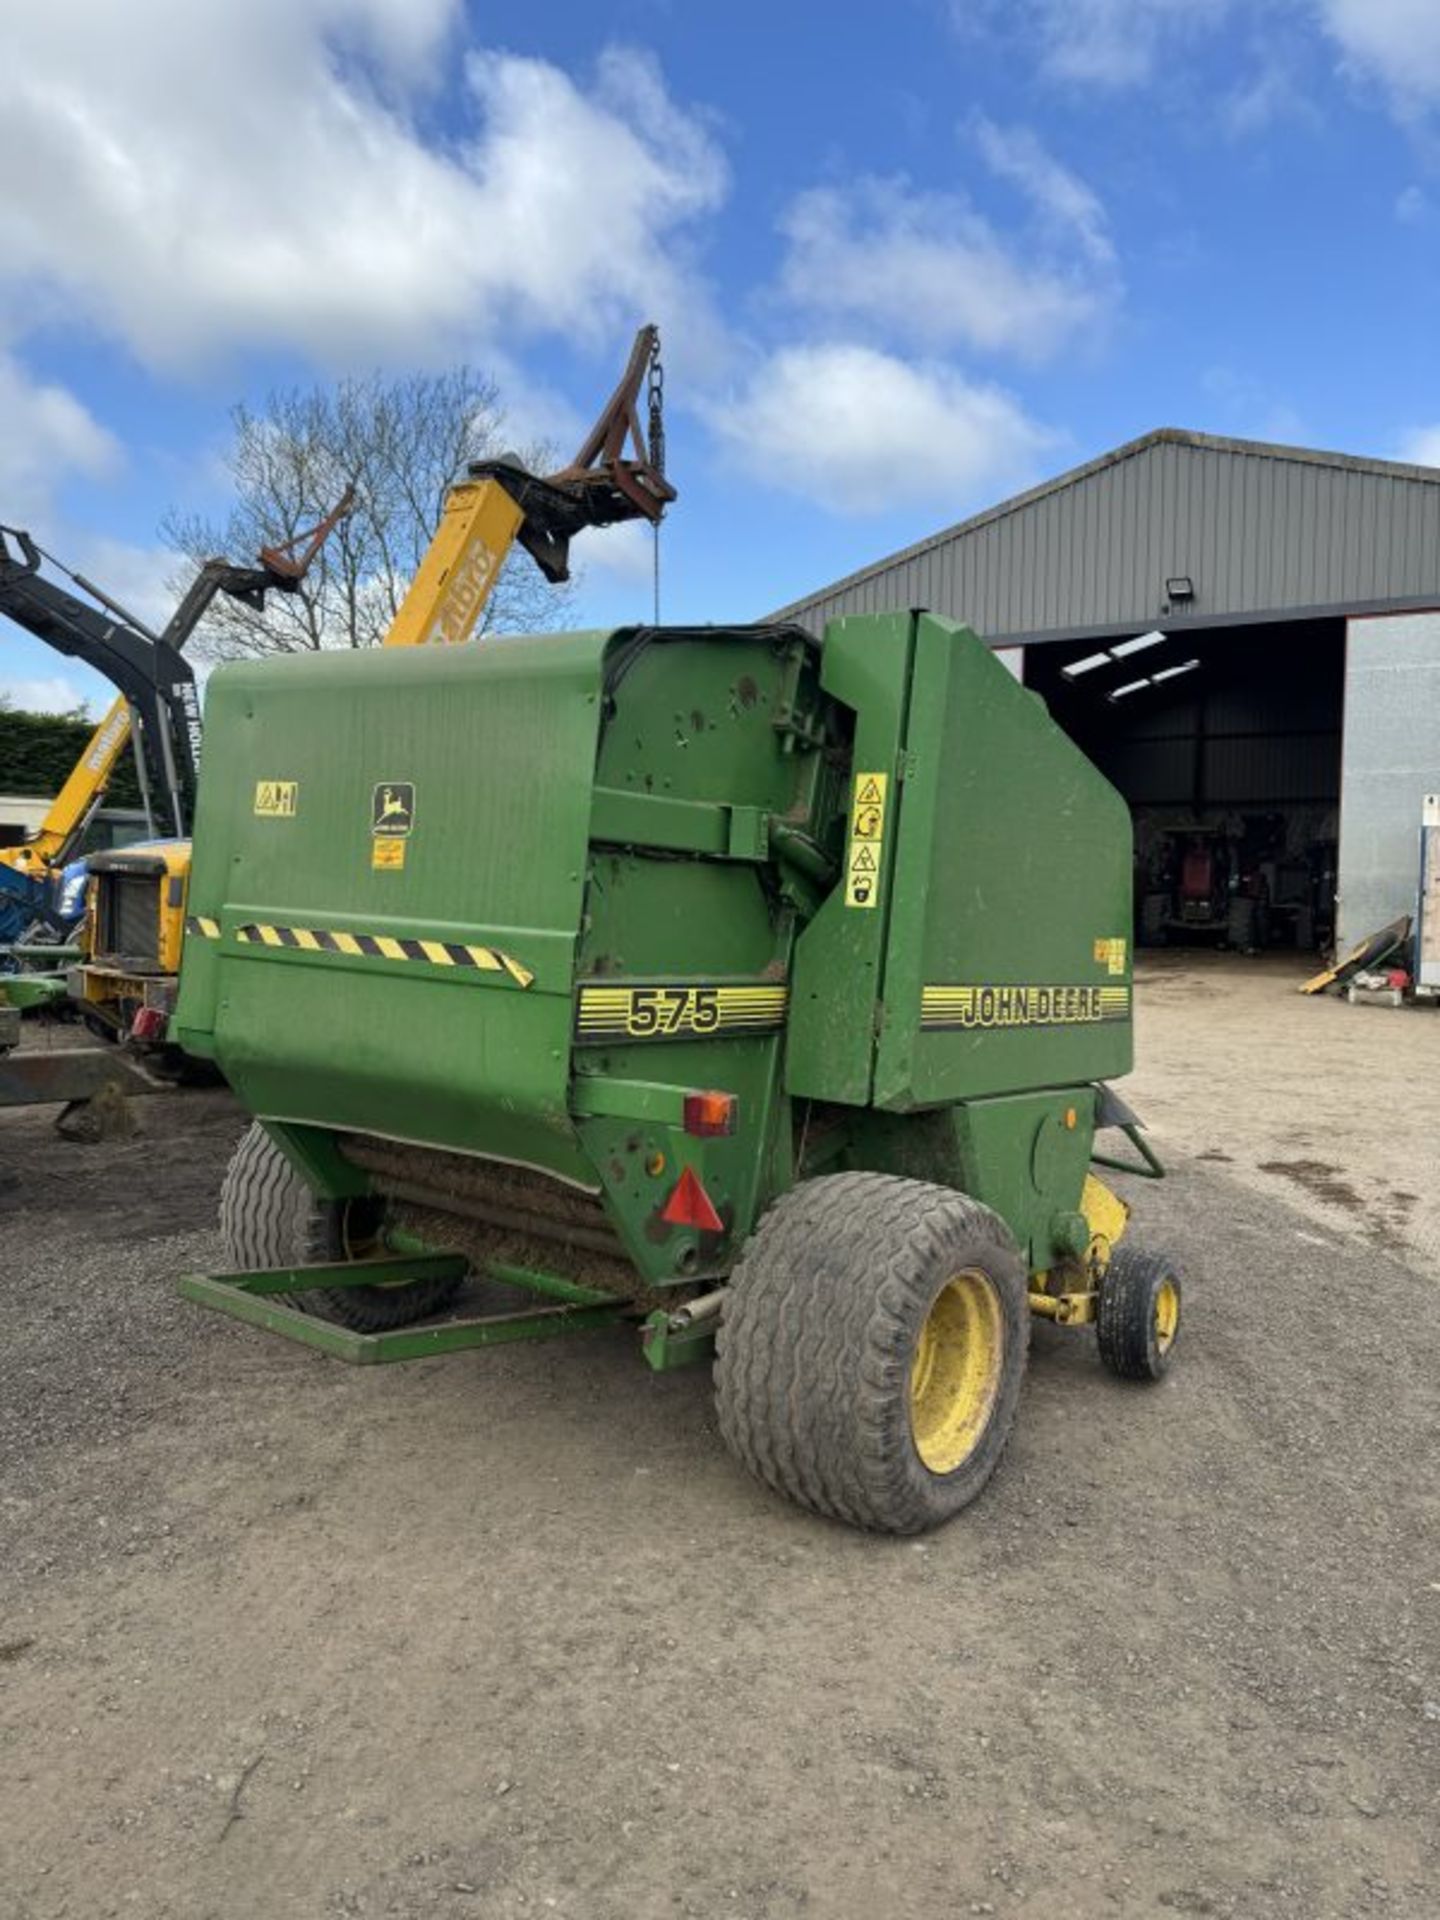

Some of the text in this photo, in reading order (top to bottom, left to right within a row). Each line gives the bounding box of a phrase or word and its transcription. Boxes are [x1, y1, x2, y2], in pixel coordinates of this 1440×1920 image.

[627, 988, 721, 1036] 575
[962, 985, 1104, 1028] JOHN DEERE
